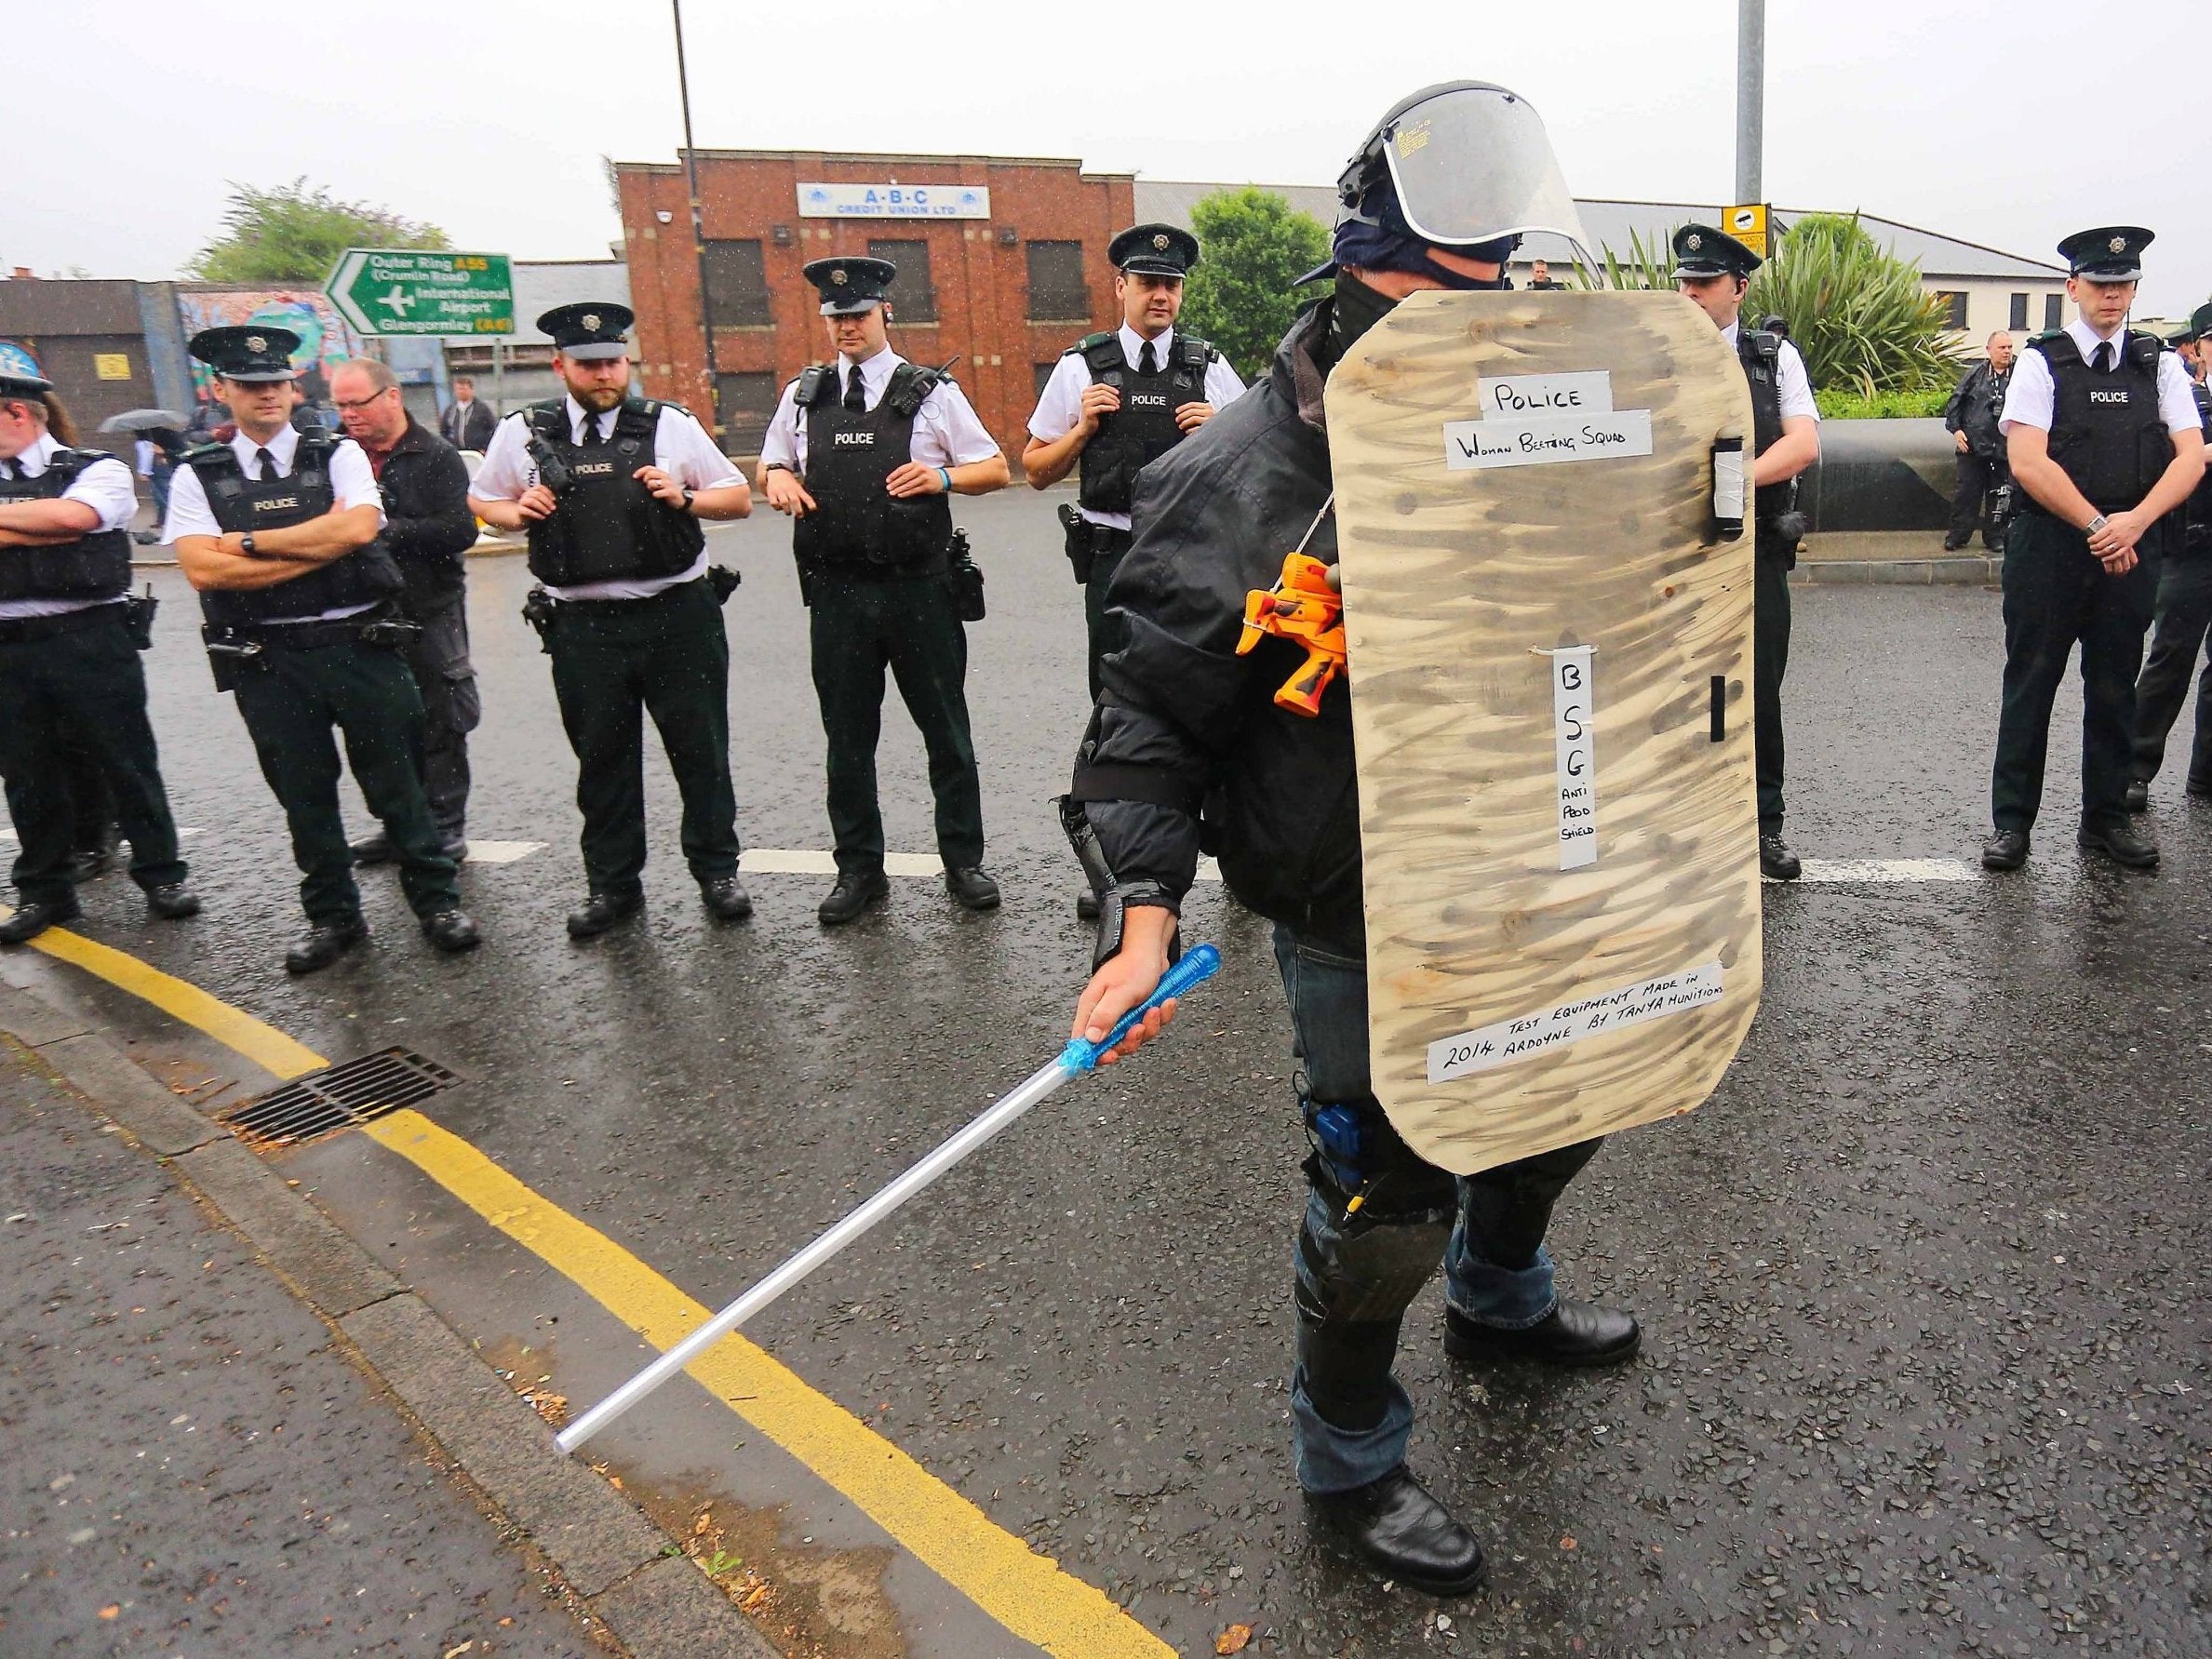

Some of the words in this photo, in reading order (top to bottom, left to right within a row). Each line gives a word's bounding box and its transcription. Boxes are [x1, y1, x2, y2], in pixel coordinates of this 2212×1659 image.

[838, 205, 882, 214] CREDIT
[888, 205, 928, 214] UNION
[932, 206, 957, 215] LTD
[369, 256, 413, 269] Outer
[418, 257, 453, 272] Ring
[372, 269, 430, 282] (Crumlin
[429, 270, 471, 283] Road)
[416, 287, 511, 300] International
[438, 300, 492, 314] Airport
[379, 317, 474, 332] Glengormley
[1131, 395, 1167, 406] POLICE
[2090, 391, 2129, 403] POLICE
[834, 433, 875, 445] POLICE
[574, 462, 613, 475] POLICE
[252, 497, 300, 512] POLICE
[1509, 1018, 1540, 1035] TEST
[1551, 987, 1634, 1021] EQUIPMENT
[1642, 979, 1678, 997] MADE
[1443, 1043, 1495, 1069] 2014
[1503, 1027, 1572, 1057] ARDOYNE
[1616, 996, 1663, 1021] TANYA
